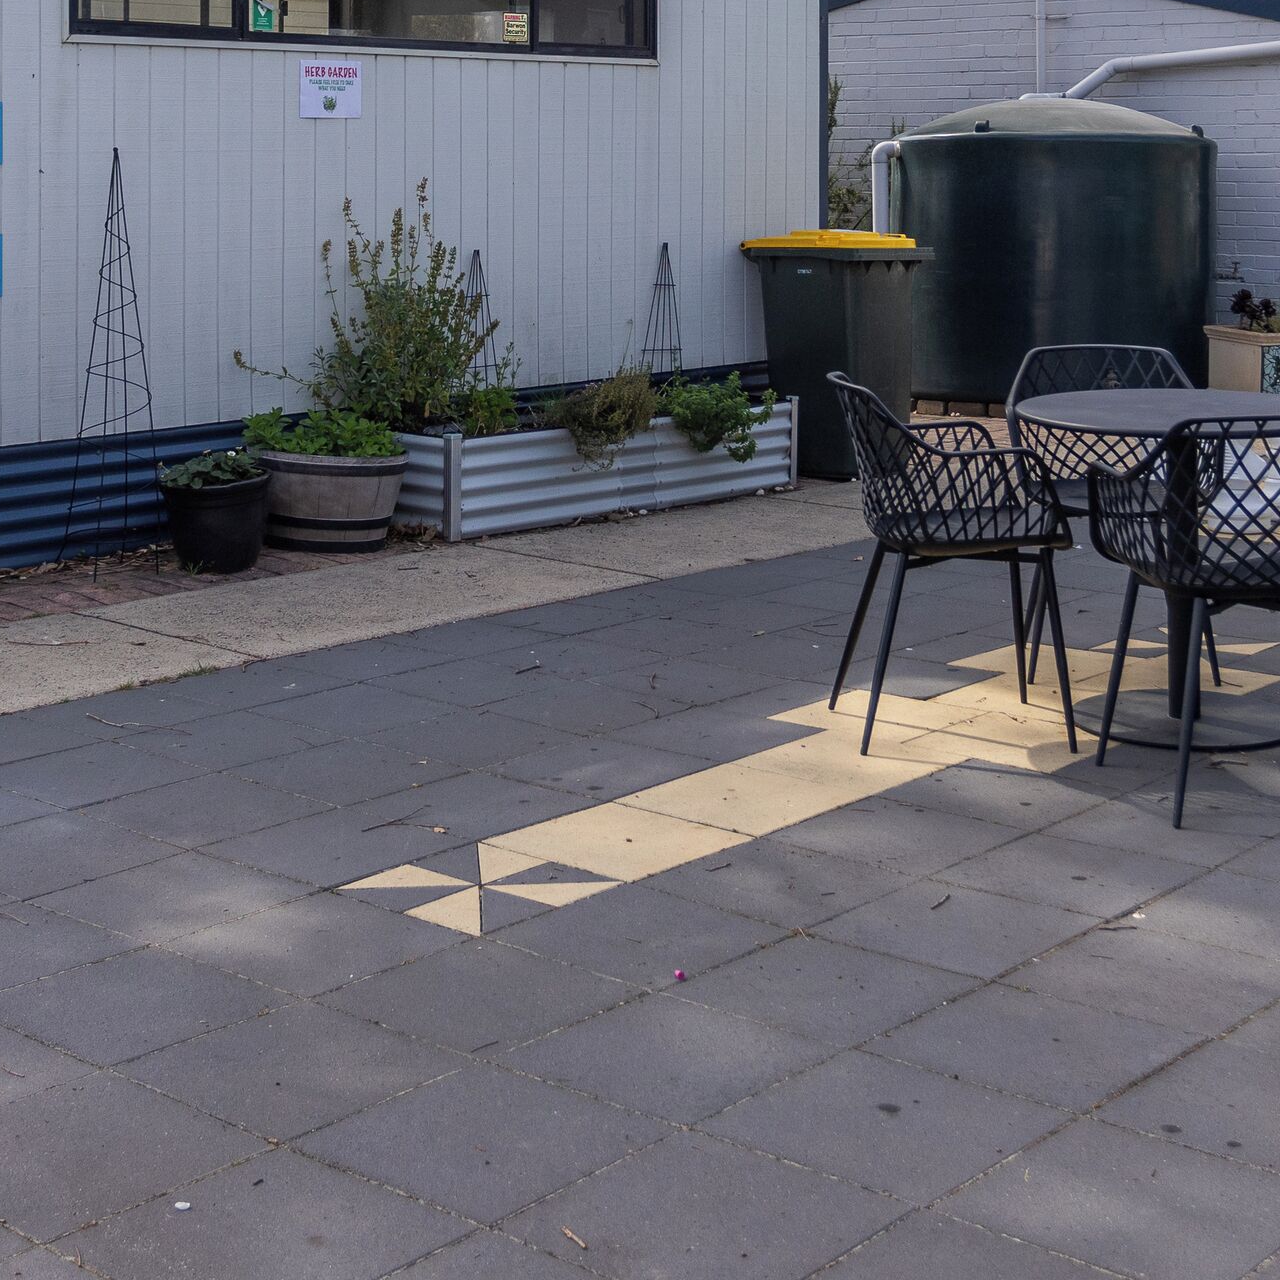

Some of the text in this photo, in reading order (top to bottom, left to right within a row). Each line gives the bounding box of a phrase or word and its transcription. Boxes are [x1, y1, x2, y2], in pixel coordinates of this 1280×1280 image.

[506, 28, 526, 36] Security
[304, 66, 358, 79] HERB GARDEN
